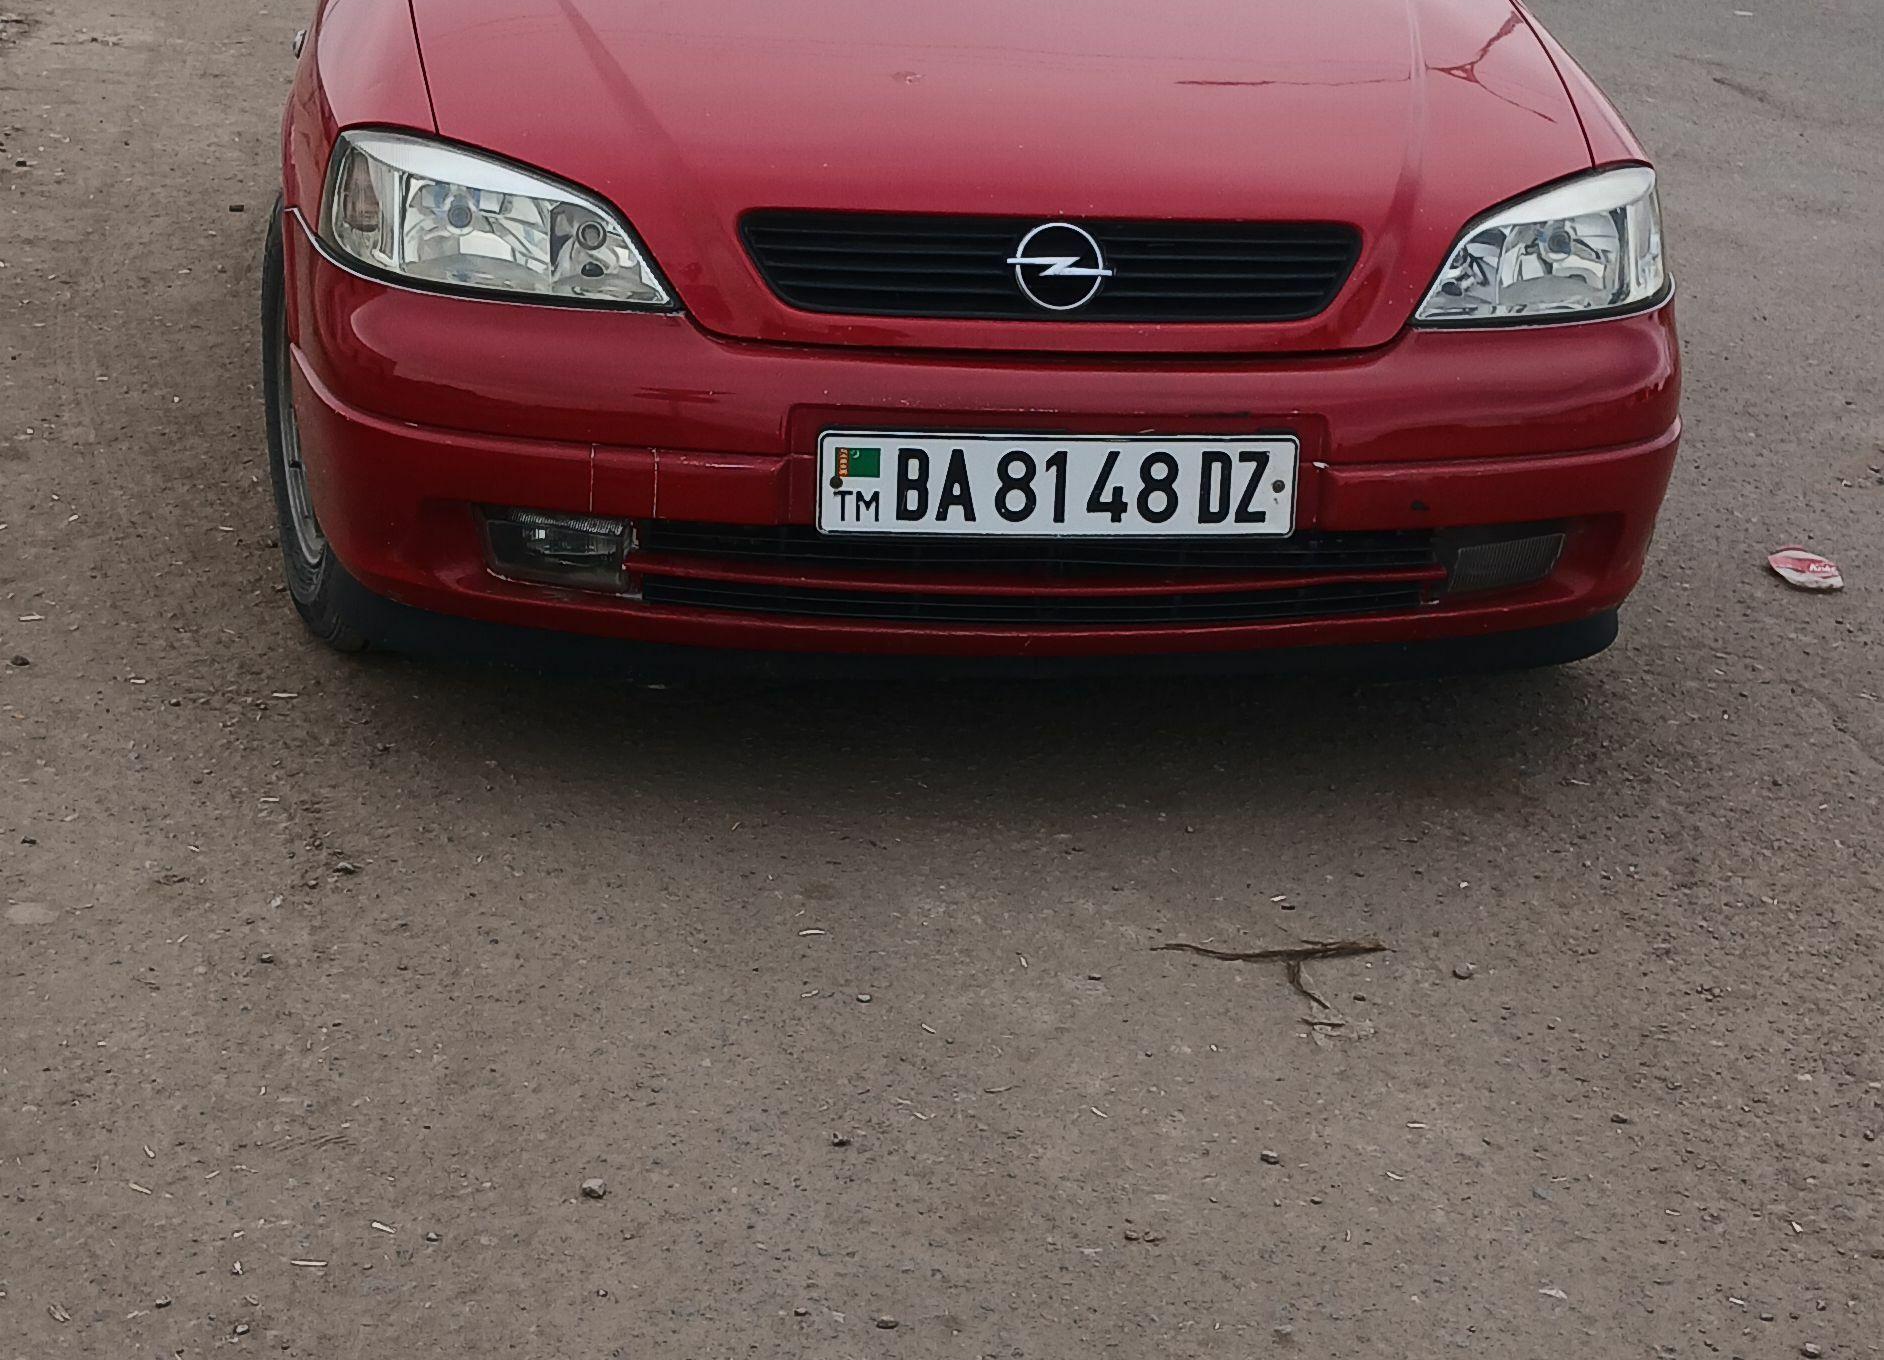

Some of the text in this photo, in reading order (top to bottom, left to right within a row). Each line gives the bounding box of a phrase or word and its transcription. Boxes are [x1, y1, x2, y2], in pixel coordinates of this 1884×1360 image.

[833, 490, 881, 523] TM
[895, 448, 976, 522] BA
[1198, 451, 1270, 524] DZ
